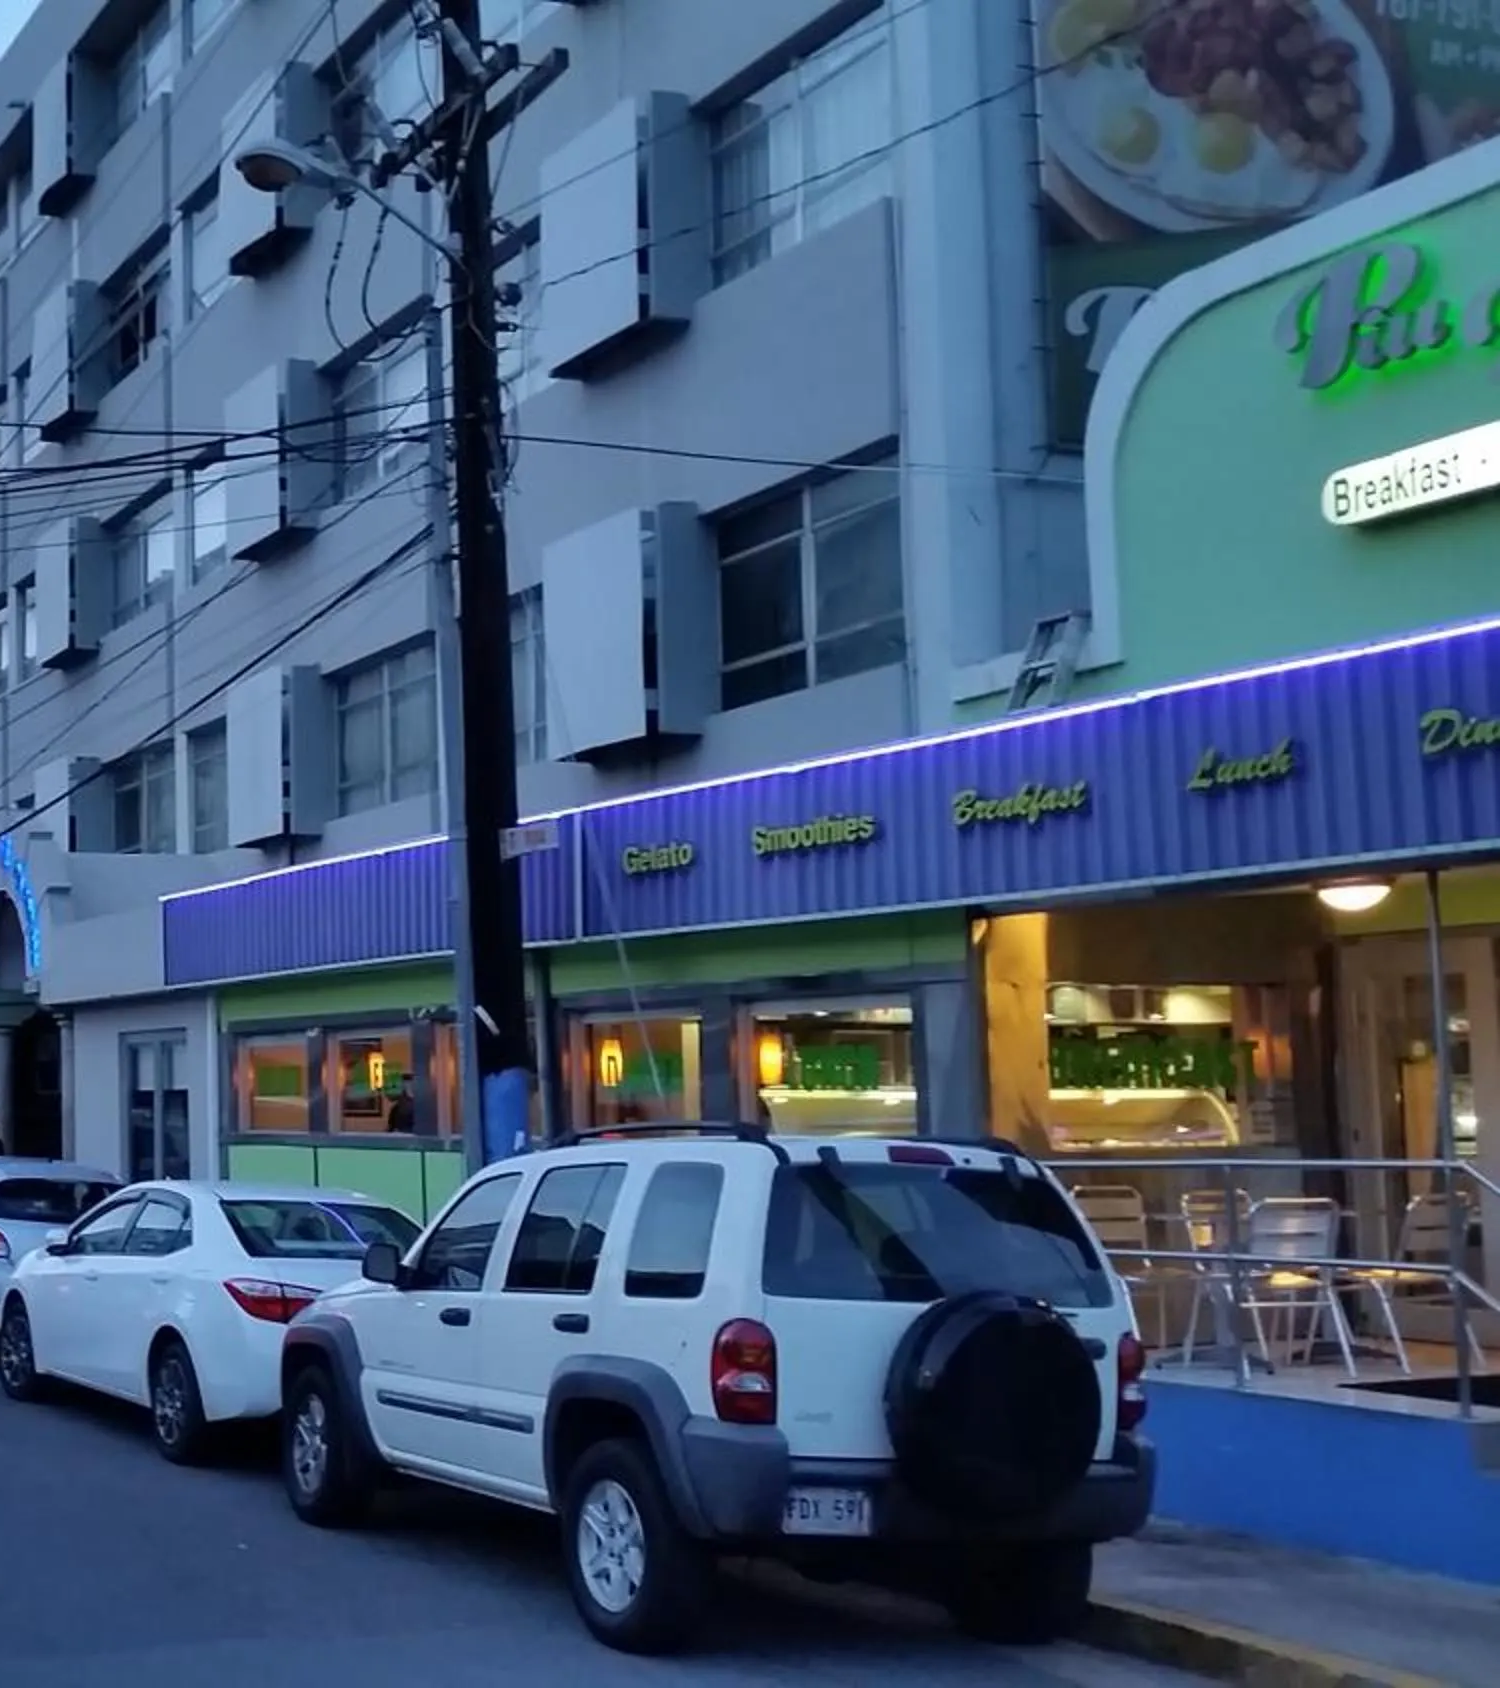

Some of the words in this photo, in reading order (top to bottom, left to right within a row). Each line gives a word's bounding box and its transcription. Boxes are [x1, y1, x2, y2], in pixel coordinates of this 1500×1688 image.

[1333, 453, 1462, 518] Breakfast
[622, 841, 693, 875] Gelato
[753, 814, 875, 855] Smoothies
[952, 780, 1086, 826] Breakfast
[1187, 738, 1293, 791] Lunch
